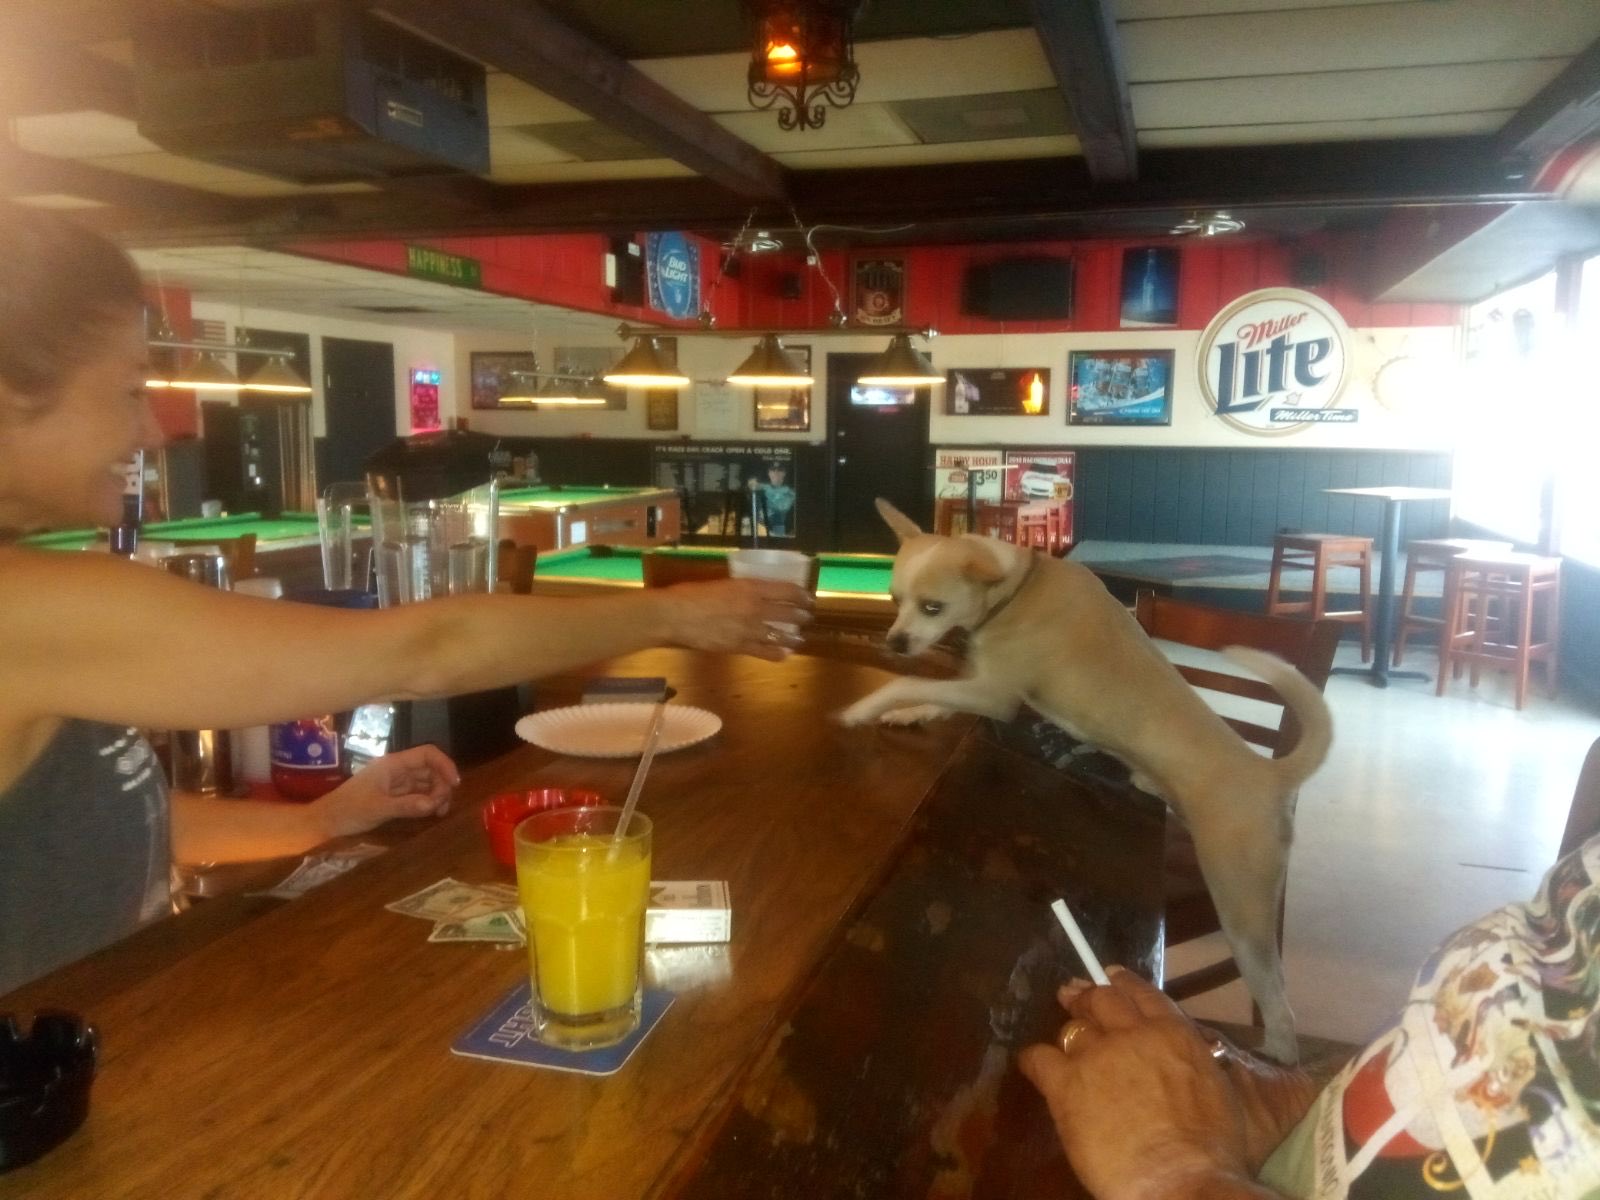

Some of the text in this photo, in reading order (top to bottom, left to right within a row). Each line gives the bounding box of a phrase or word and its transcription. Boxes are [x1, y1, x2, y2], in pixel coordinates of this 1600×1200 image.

[408, 247, 463, 279] HAPPINESS
[668, 256, 687, 272] BUD
[664, 266, 689, 283] LIGHT
[1236, 312, 1308, 348] Miller
[1213, 332, 1334, 416] Lite
[702, 446, 724, 454] CRACK
[753, 447, 773, 455] COLD
[939, 455, 998, 465] HAPPY HOUR
